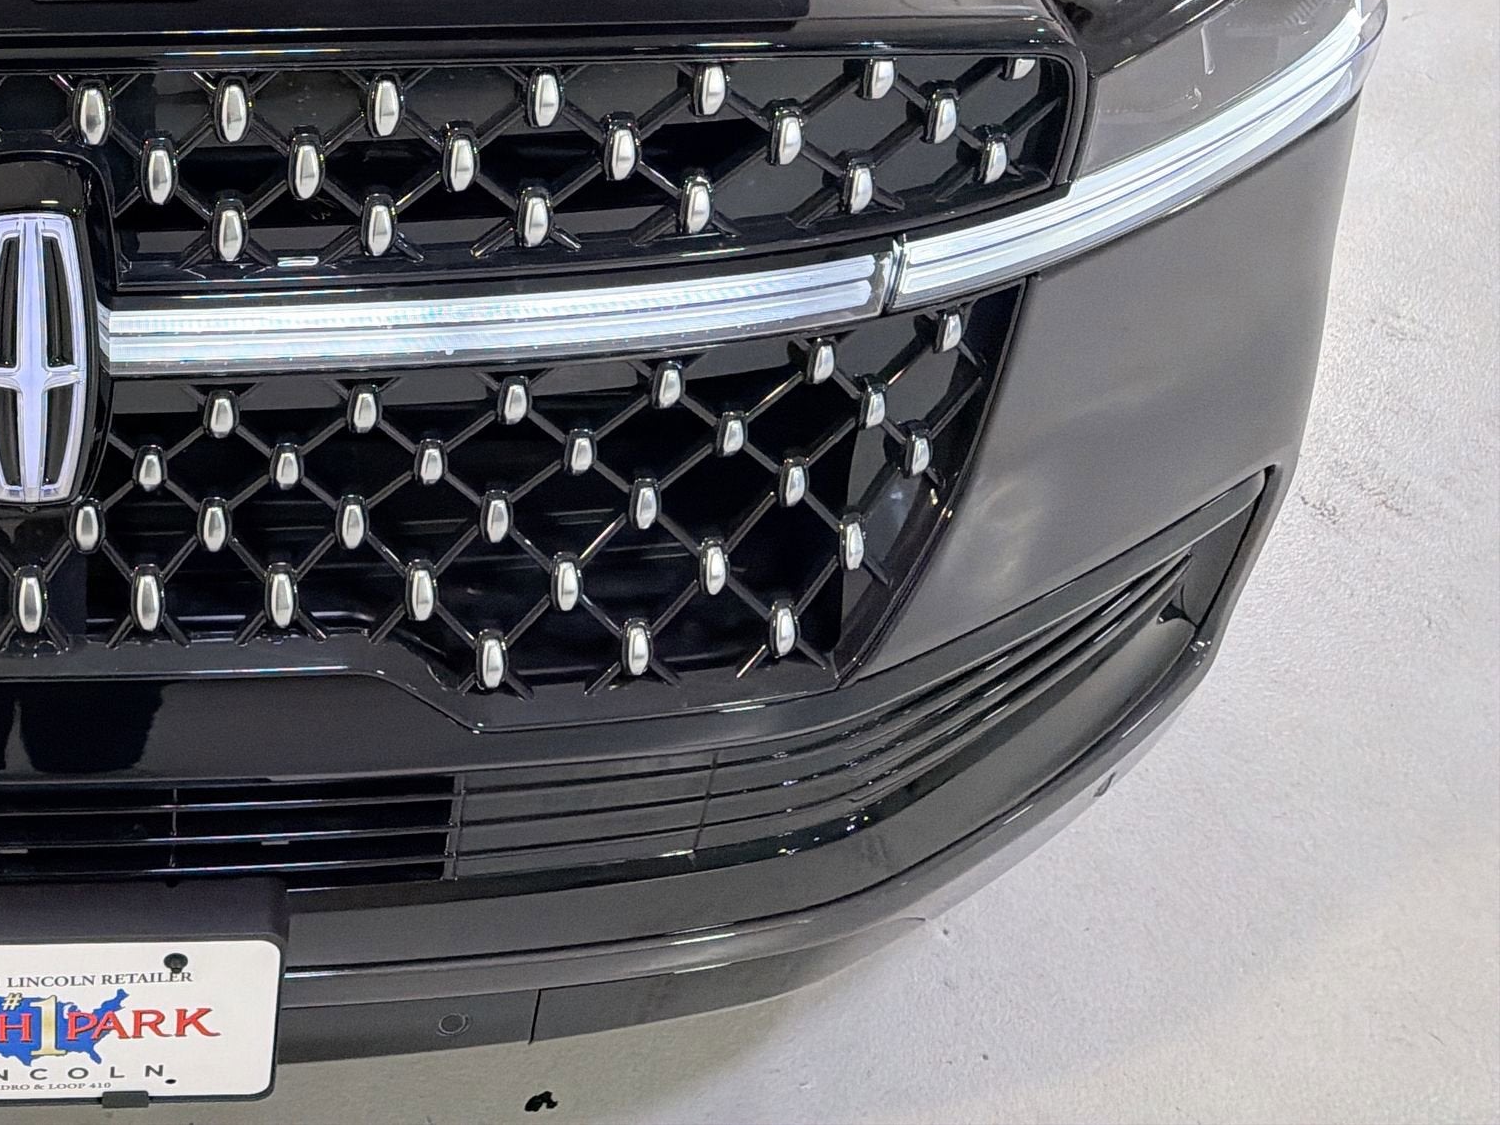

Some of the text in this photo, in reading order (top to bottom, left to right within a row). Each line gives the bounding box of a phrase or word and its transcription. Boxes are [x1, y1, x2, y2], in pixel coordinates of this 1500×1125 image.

[7, 975, 96, 988] LINCOLN
[101, 972, 193, 985] RETAILER
[66, 1007, 222, 1042] PARK
[49, 1082, 87, 1090] LOOP
